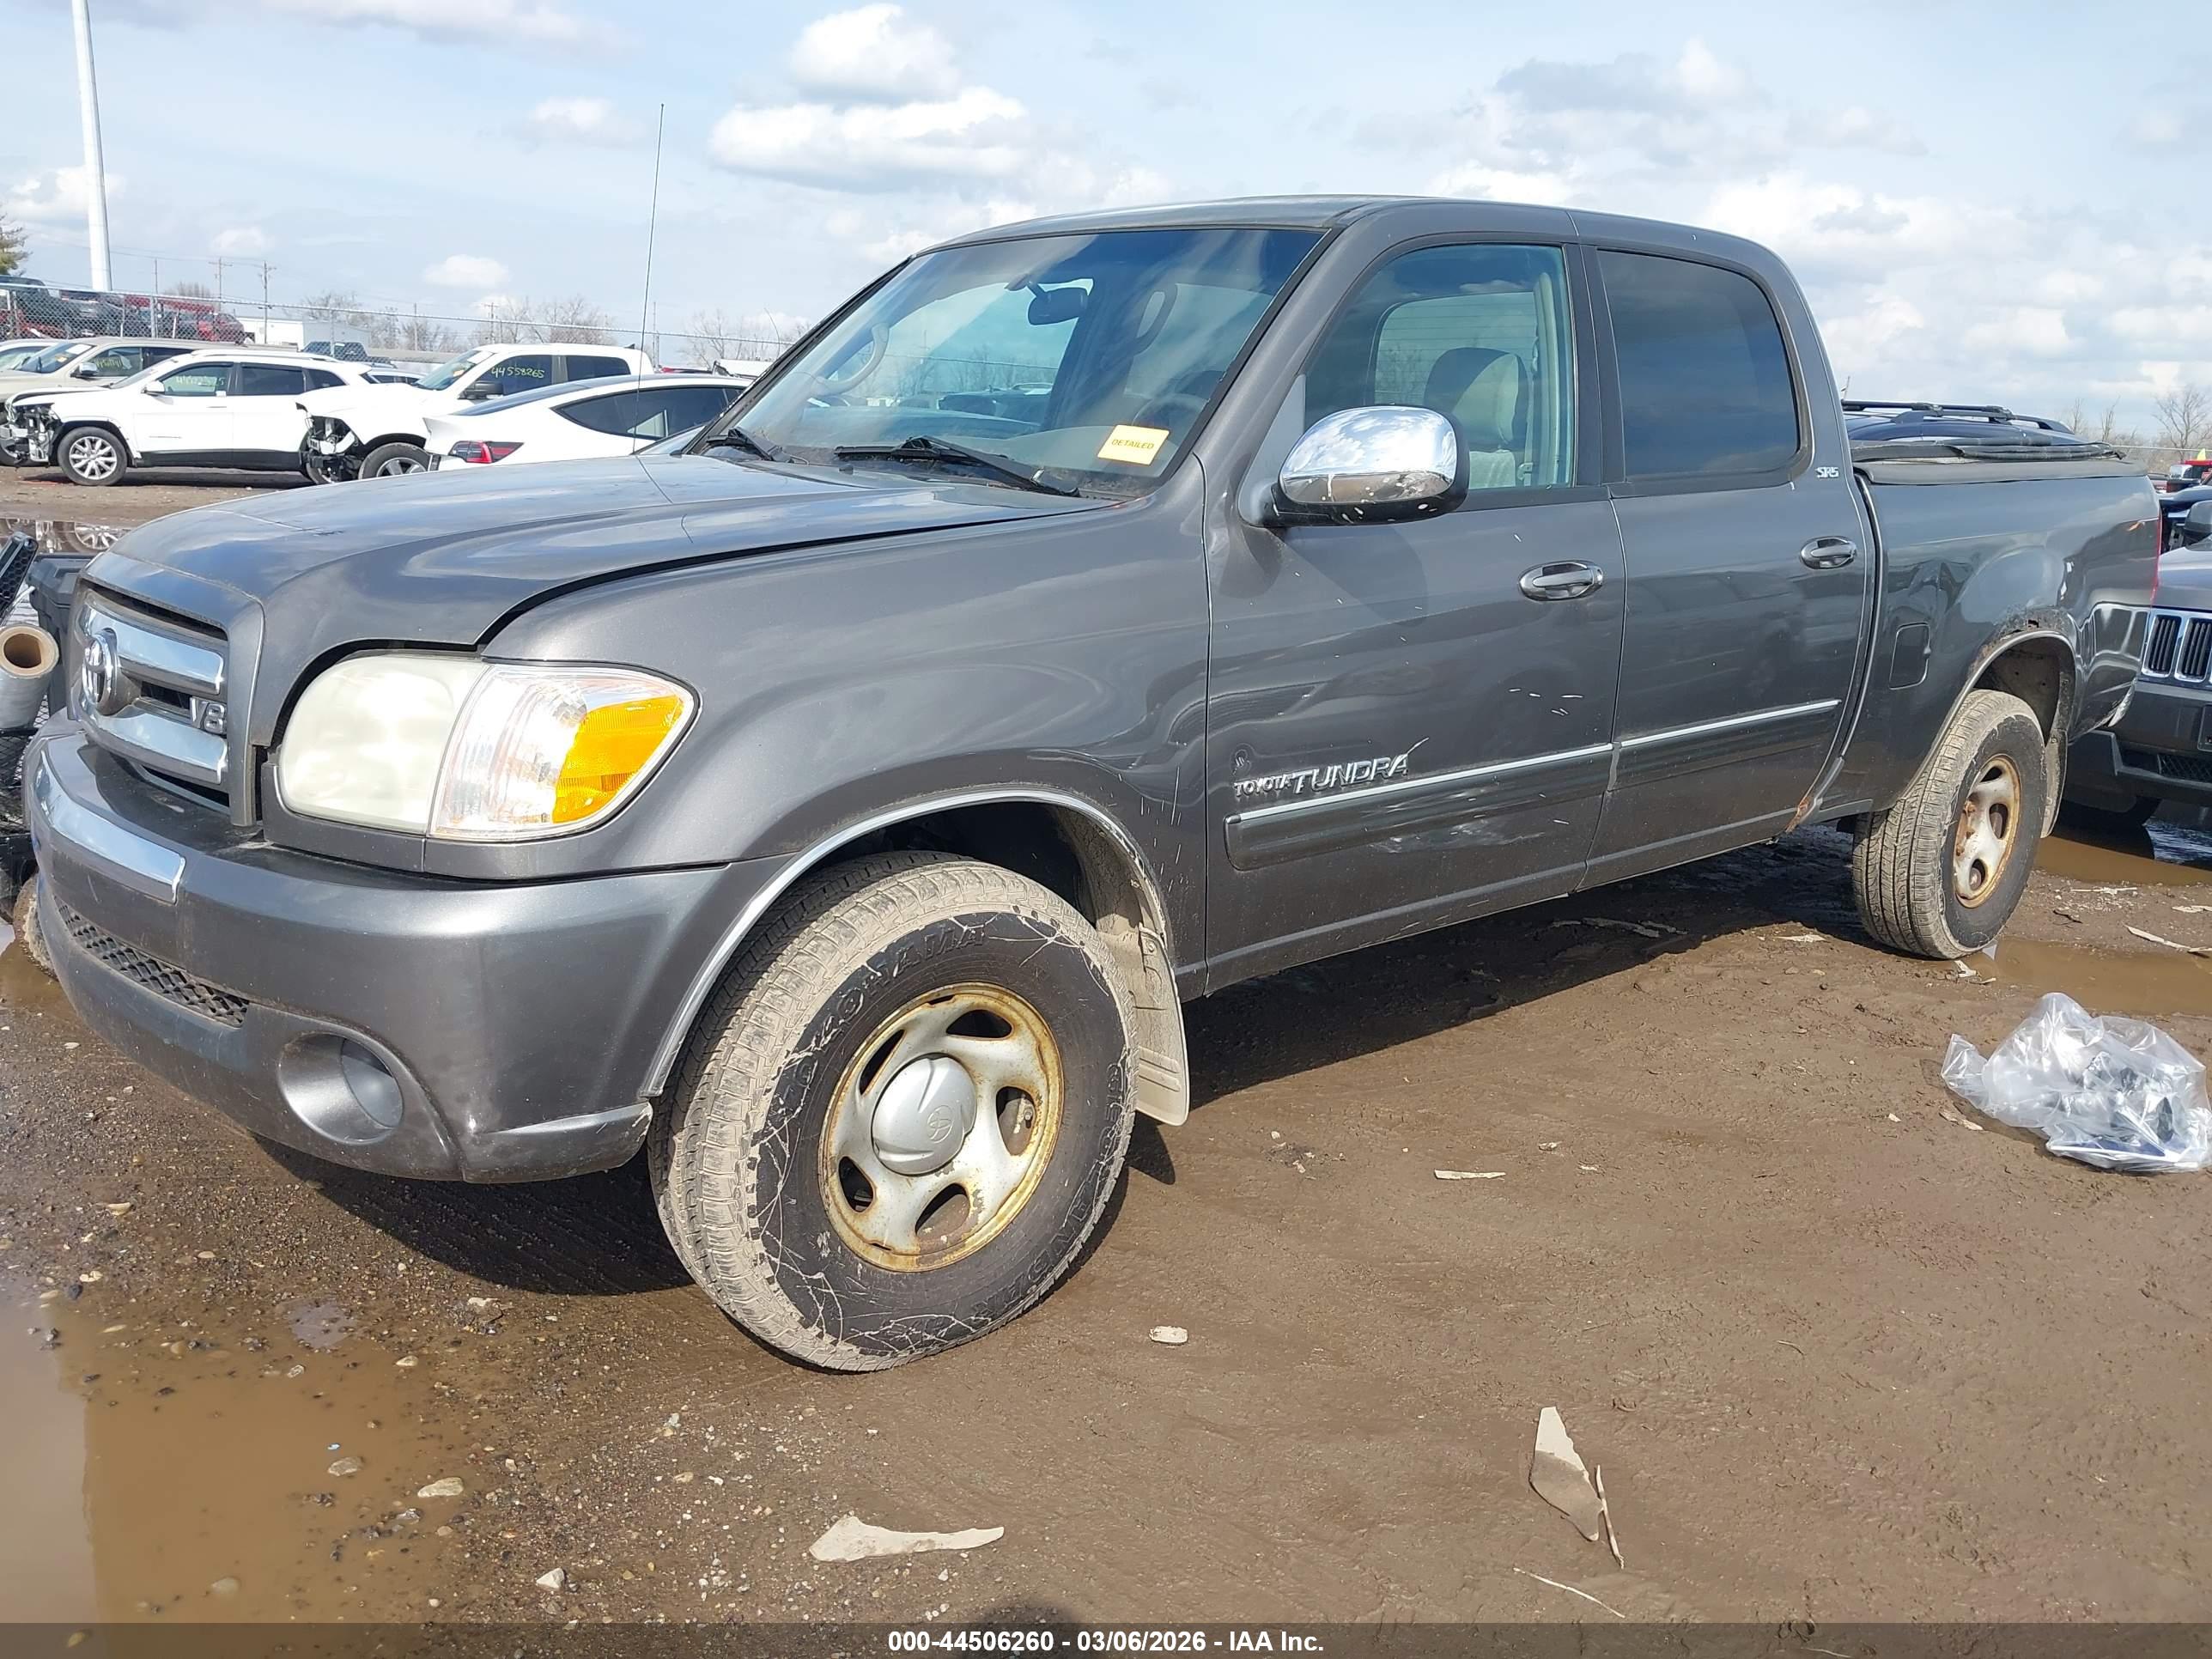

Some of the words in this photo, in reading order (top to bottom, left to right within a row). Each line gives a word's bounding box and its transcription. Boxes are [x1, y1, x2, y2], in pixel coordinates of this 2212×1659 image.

[1111, 439, 1155, 449] DETAILED
[1815, 466, 1839, 478] SR5
[190, 696, 227, 736] V8
[1234, 773, 1291, 797] TOYOTA
[1289, 737, 1429, 795] TUNDRA
